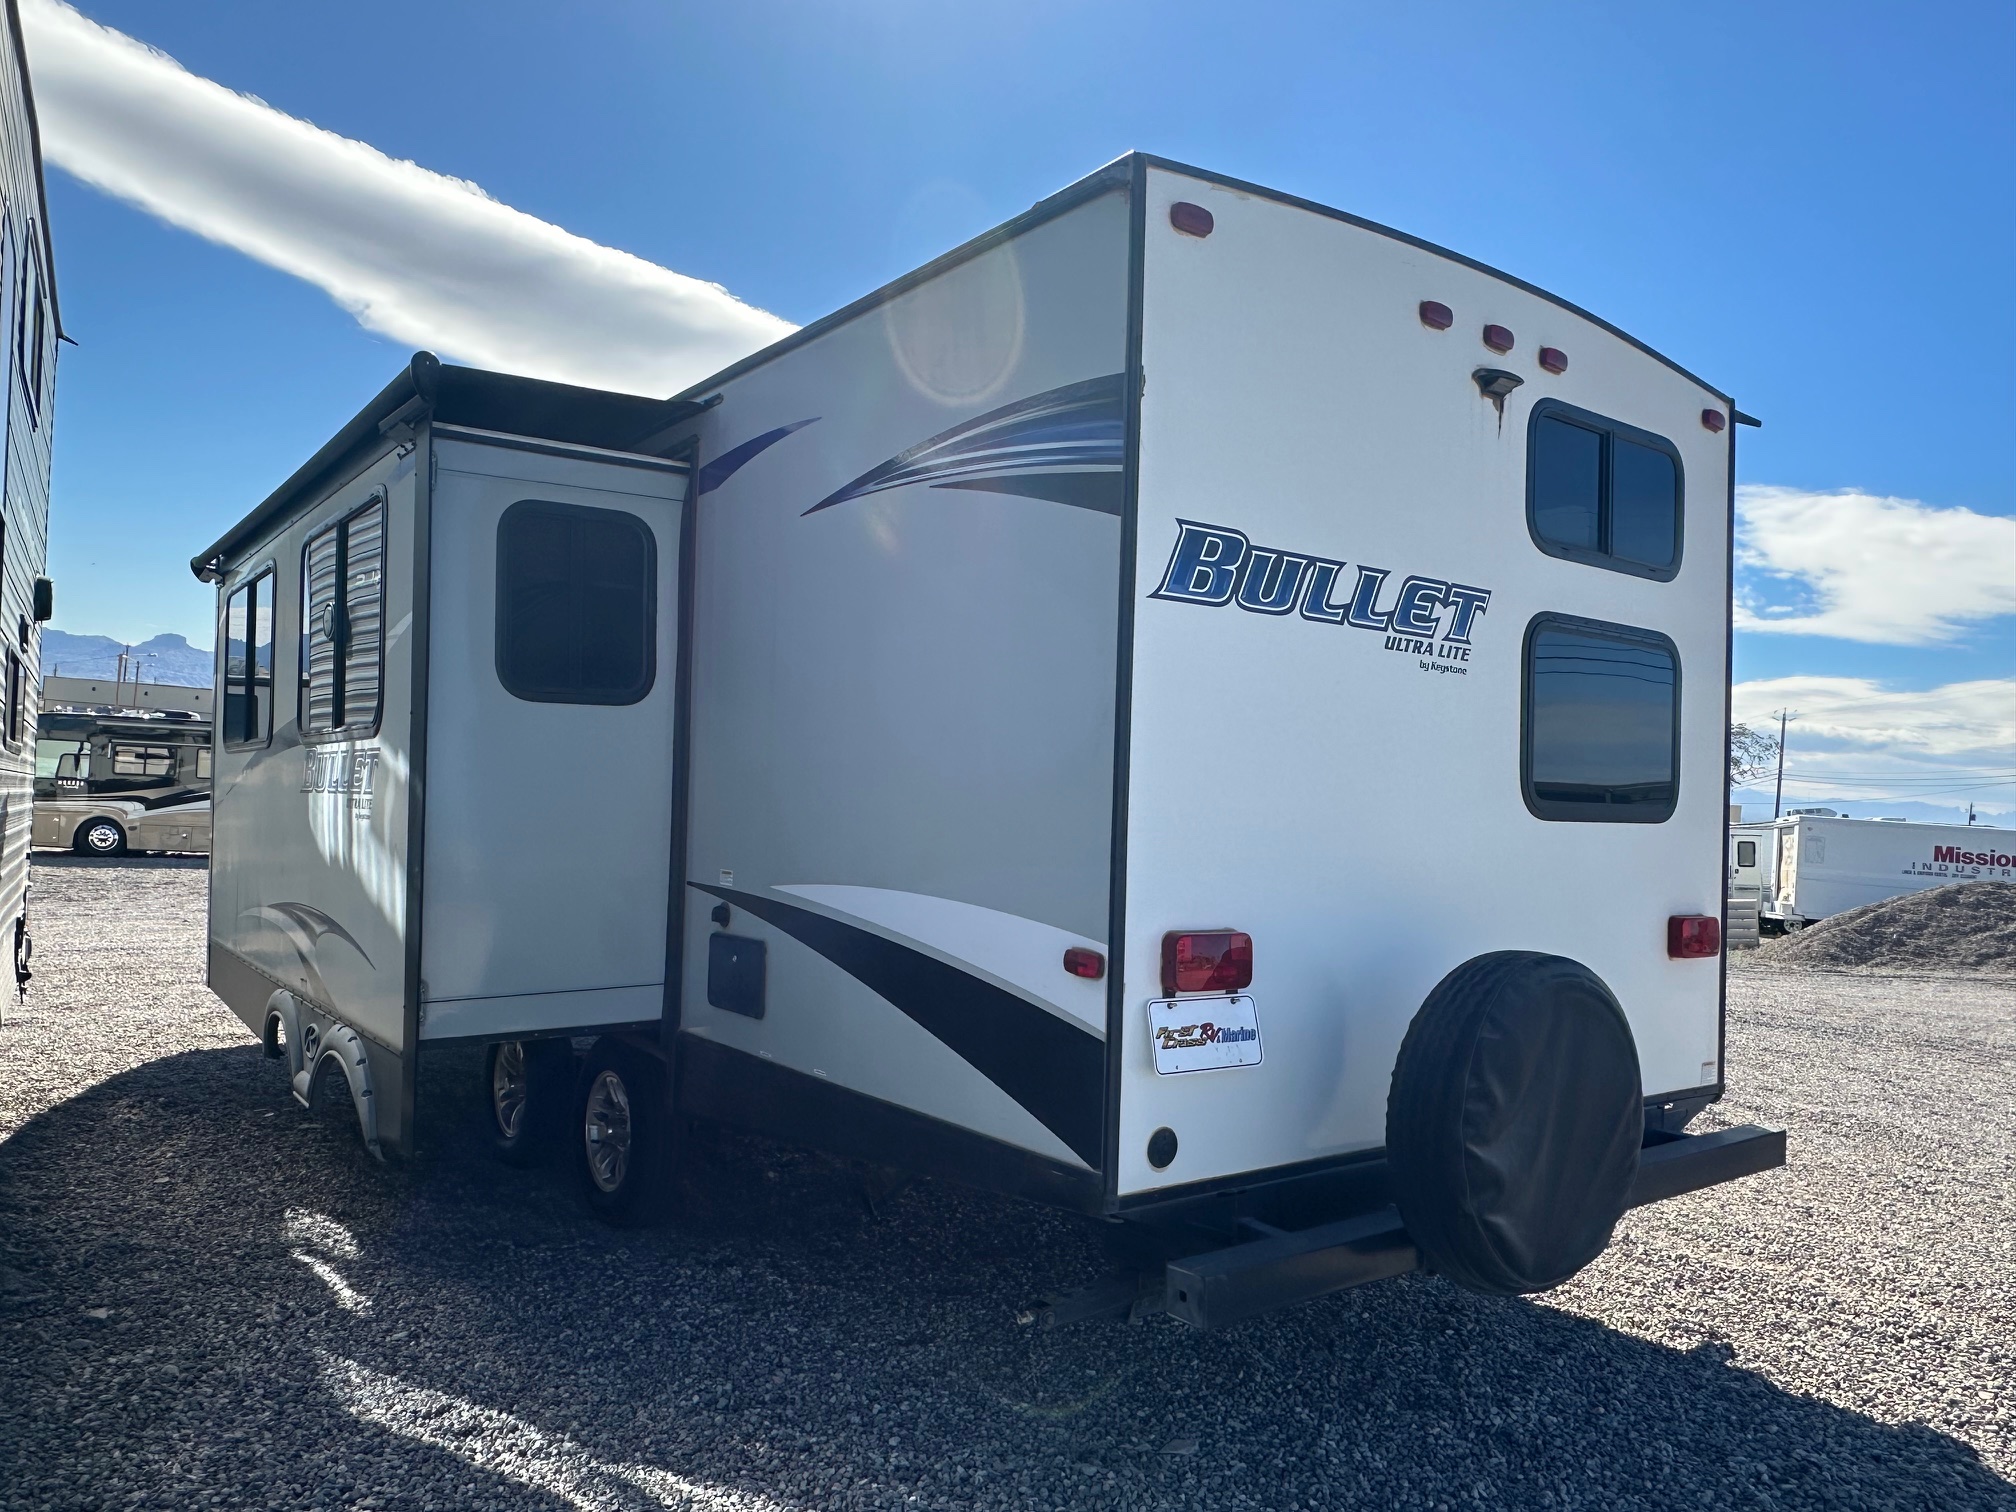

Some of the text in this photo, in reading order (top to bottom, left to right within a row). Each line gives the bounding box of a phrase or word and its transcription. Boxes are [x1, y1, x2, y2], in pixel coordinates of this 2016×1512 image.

[1146, 518, 1491, 645] BULLET
[1384, 635, 1472, 662] ULTRA LITE
[1419, 660, 1467, 675] by Keystone
[300, 746, 381, 794] BULLET
[1200, 1022, 1222, 1043] RV
[1221, 1026, 1256, 1043] Marine
